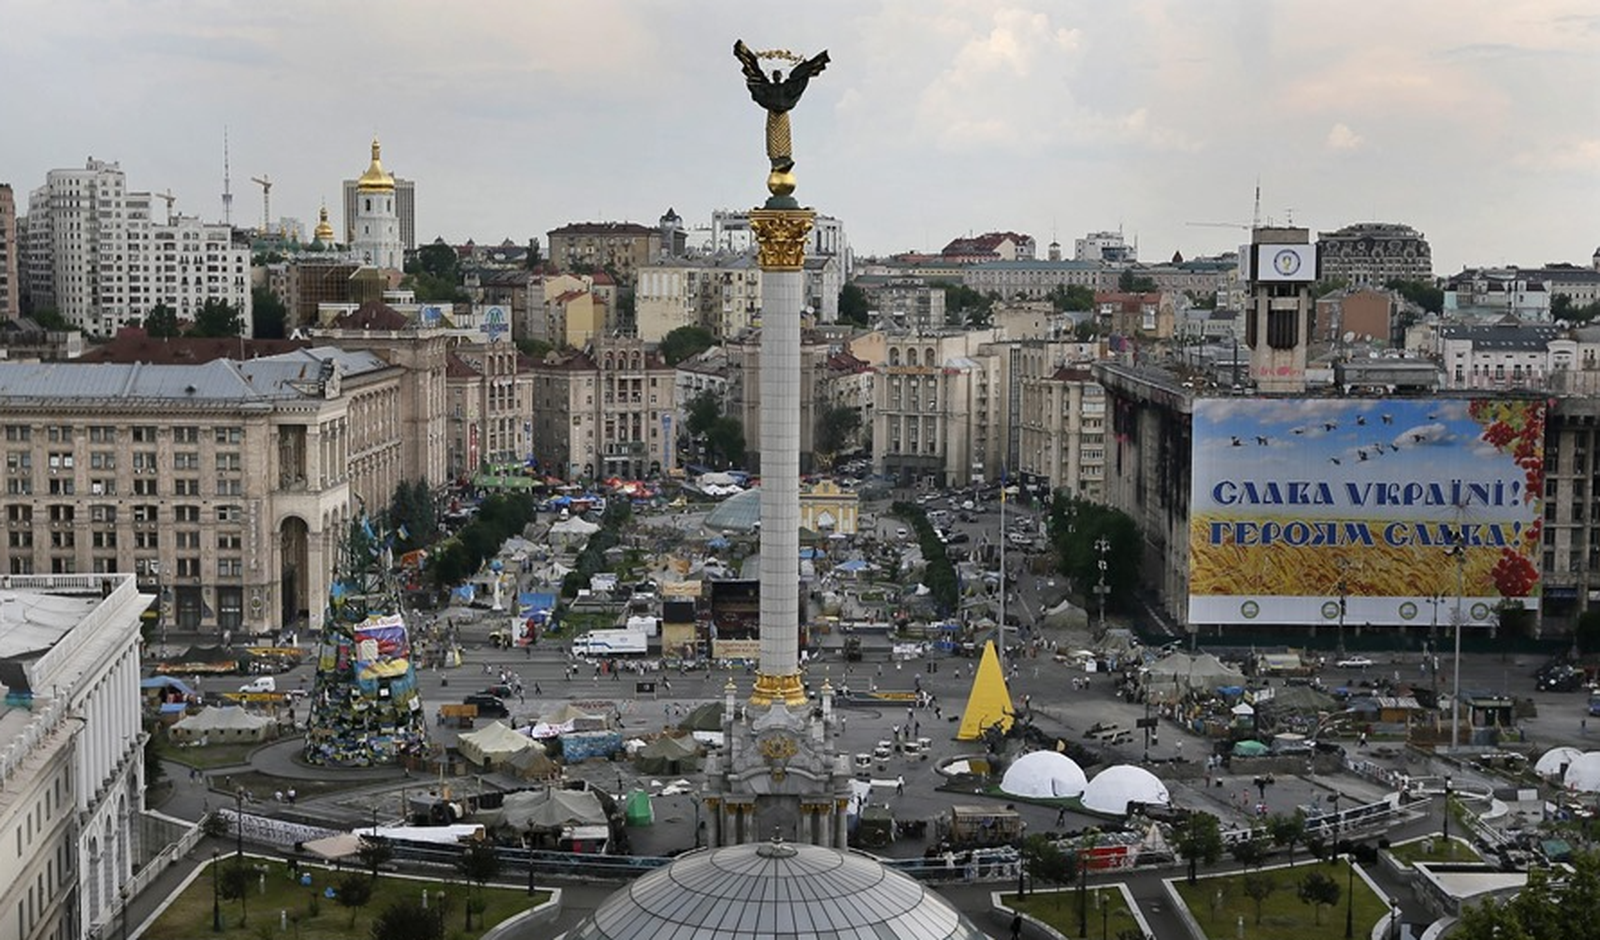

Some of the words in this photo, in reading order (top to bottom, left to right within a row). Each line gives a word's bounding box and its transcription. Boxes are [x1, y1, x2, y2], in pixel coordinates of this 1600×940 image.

[1211, 481, 1334, 506] СЛАВА
[1345, 479, 1521, 507] УКРАЇНІ!
[1210, 521, 1373, 546] ГЕРОЯМ
[1383, 521, 1522, 547] СЛАВА!
